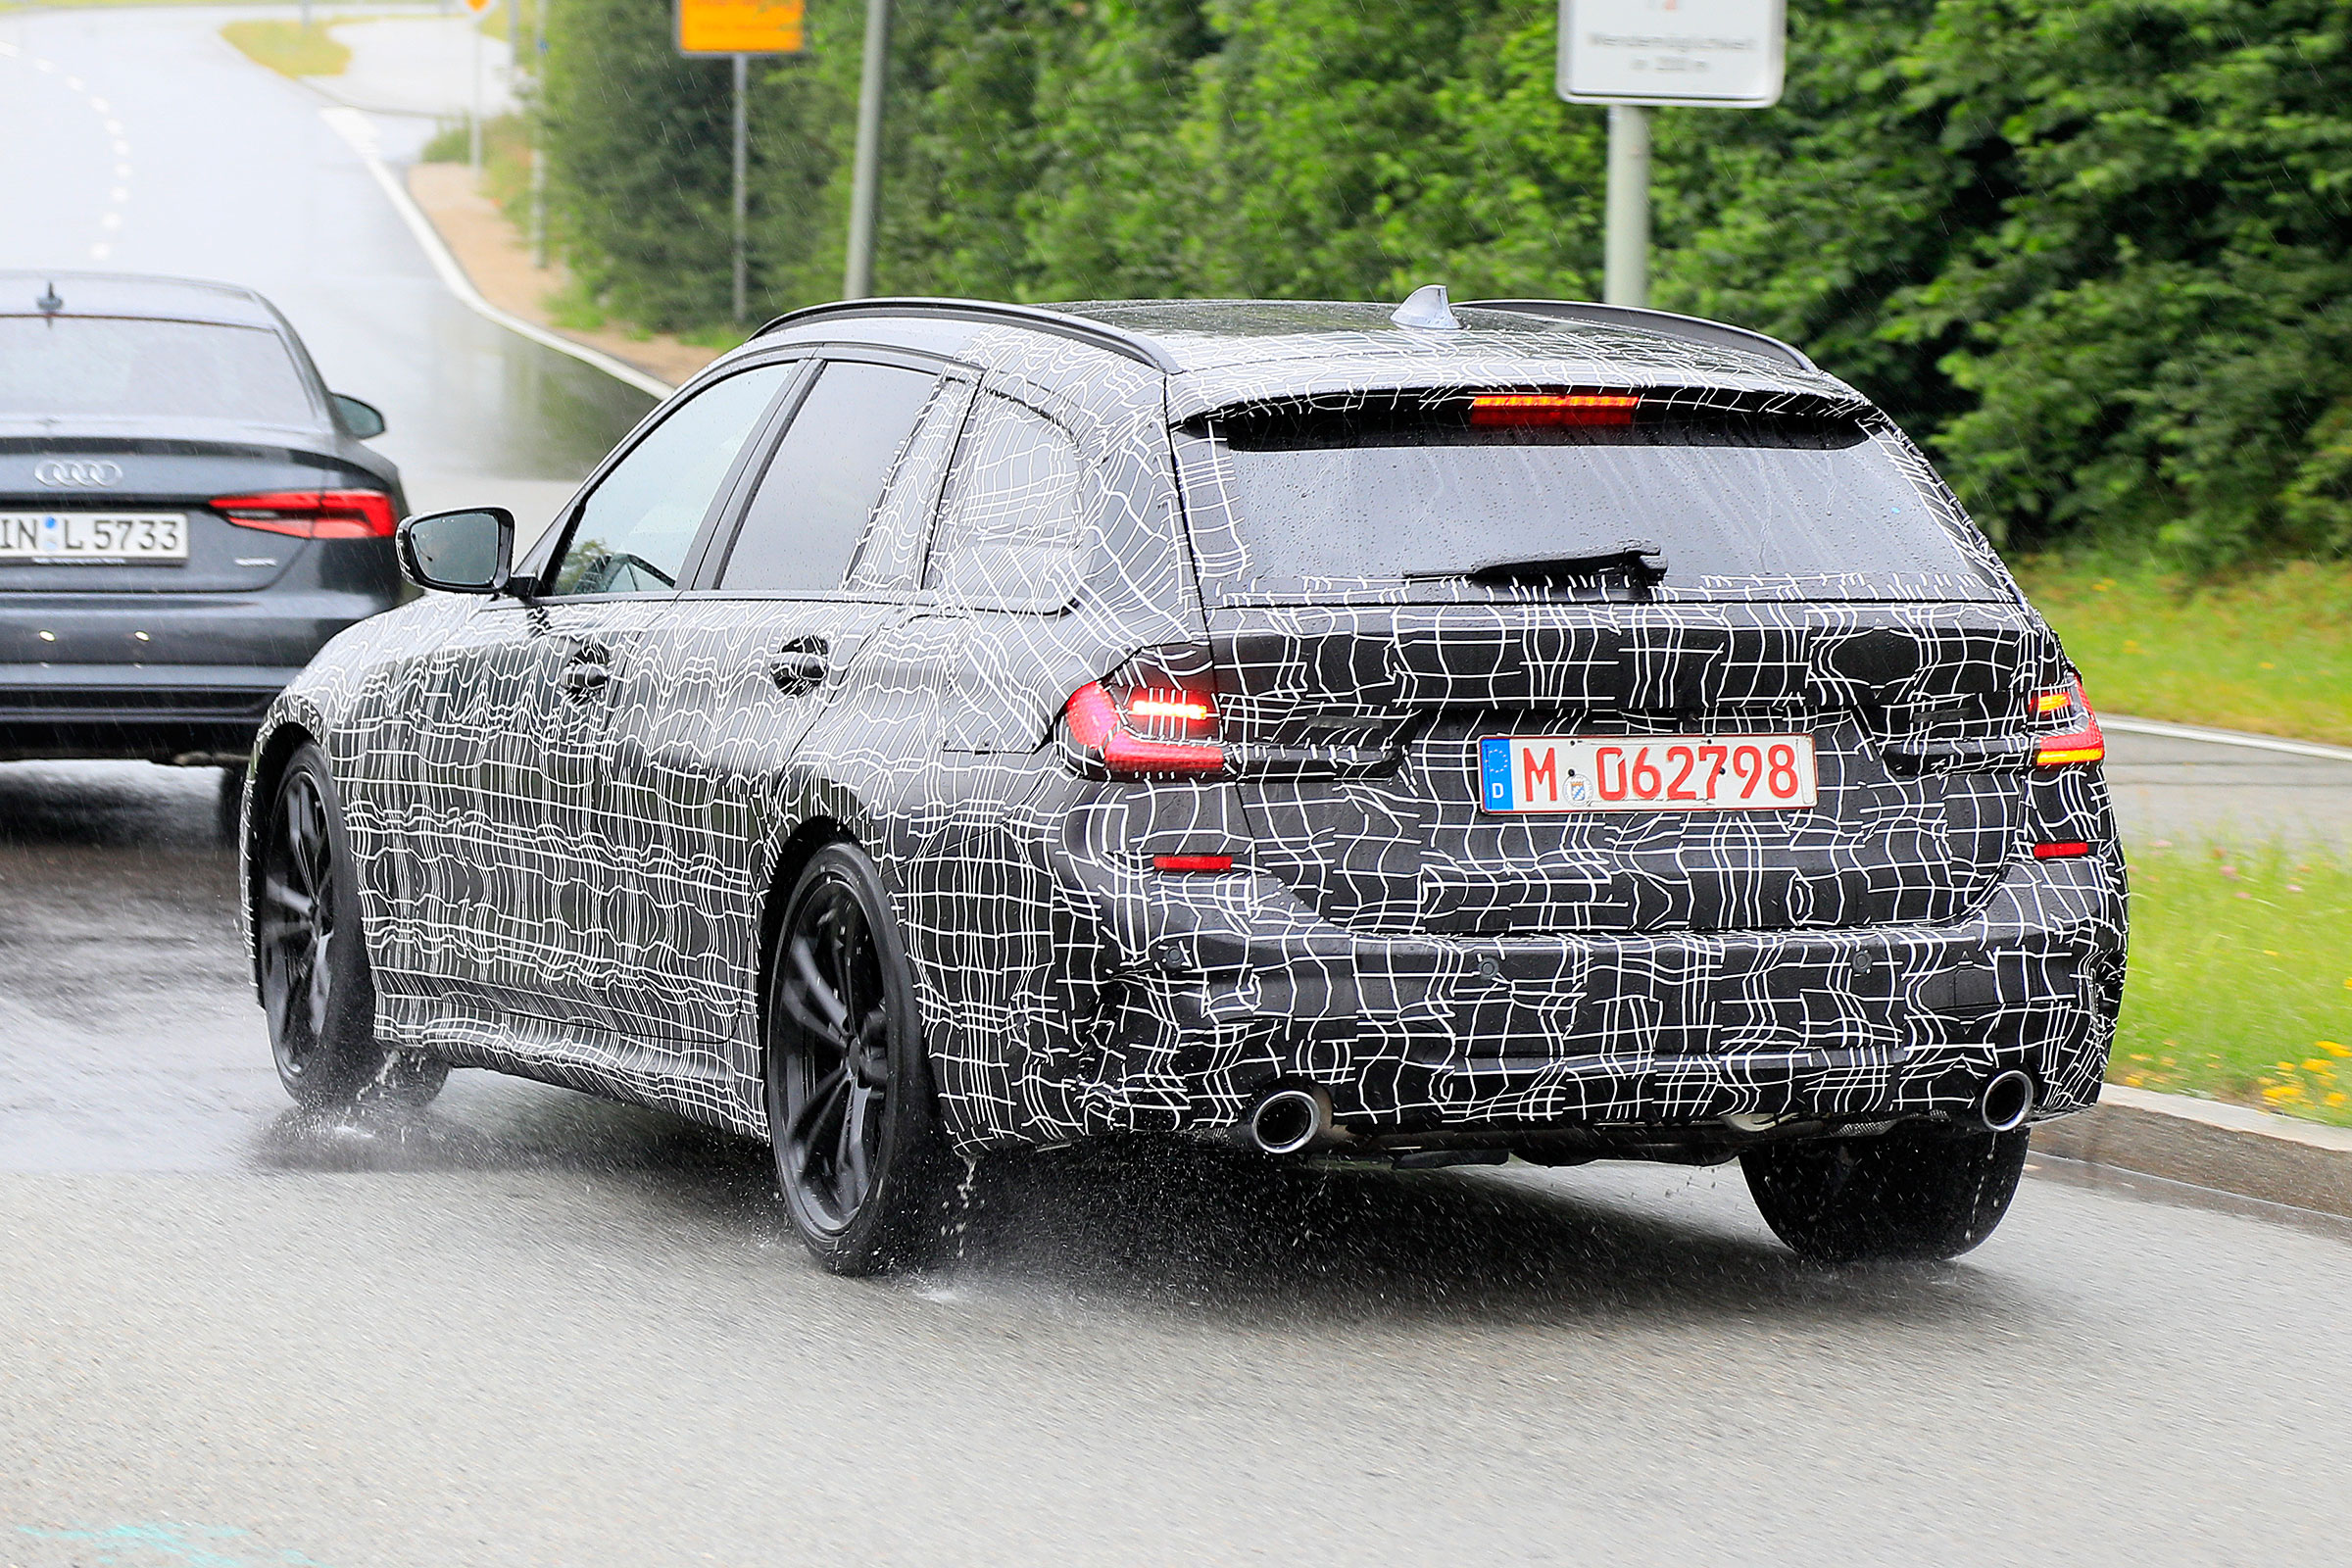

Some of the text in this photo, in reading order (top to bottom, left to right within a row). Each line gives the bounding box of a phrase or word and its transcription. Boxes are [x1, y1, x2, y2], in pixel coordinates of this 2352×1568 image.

[64, 518, 83, 550] L
[95, 519, 178, 551] 5733
[1522, 747, 1558, 802] M
[1595, 744, 1799, 802] 062798
[1492, 782, 1504, 800] D
